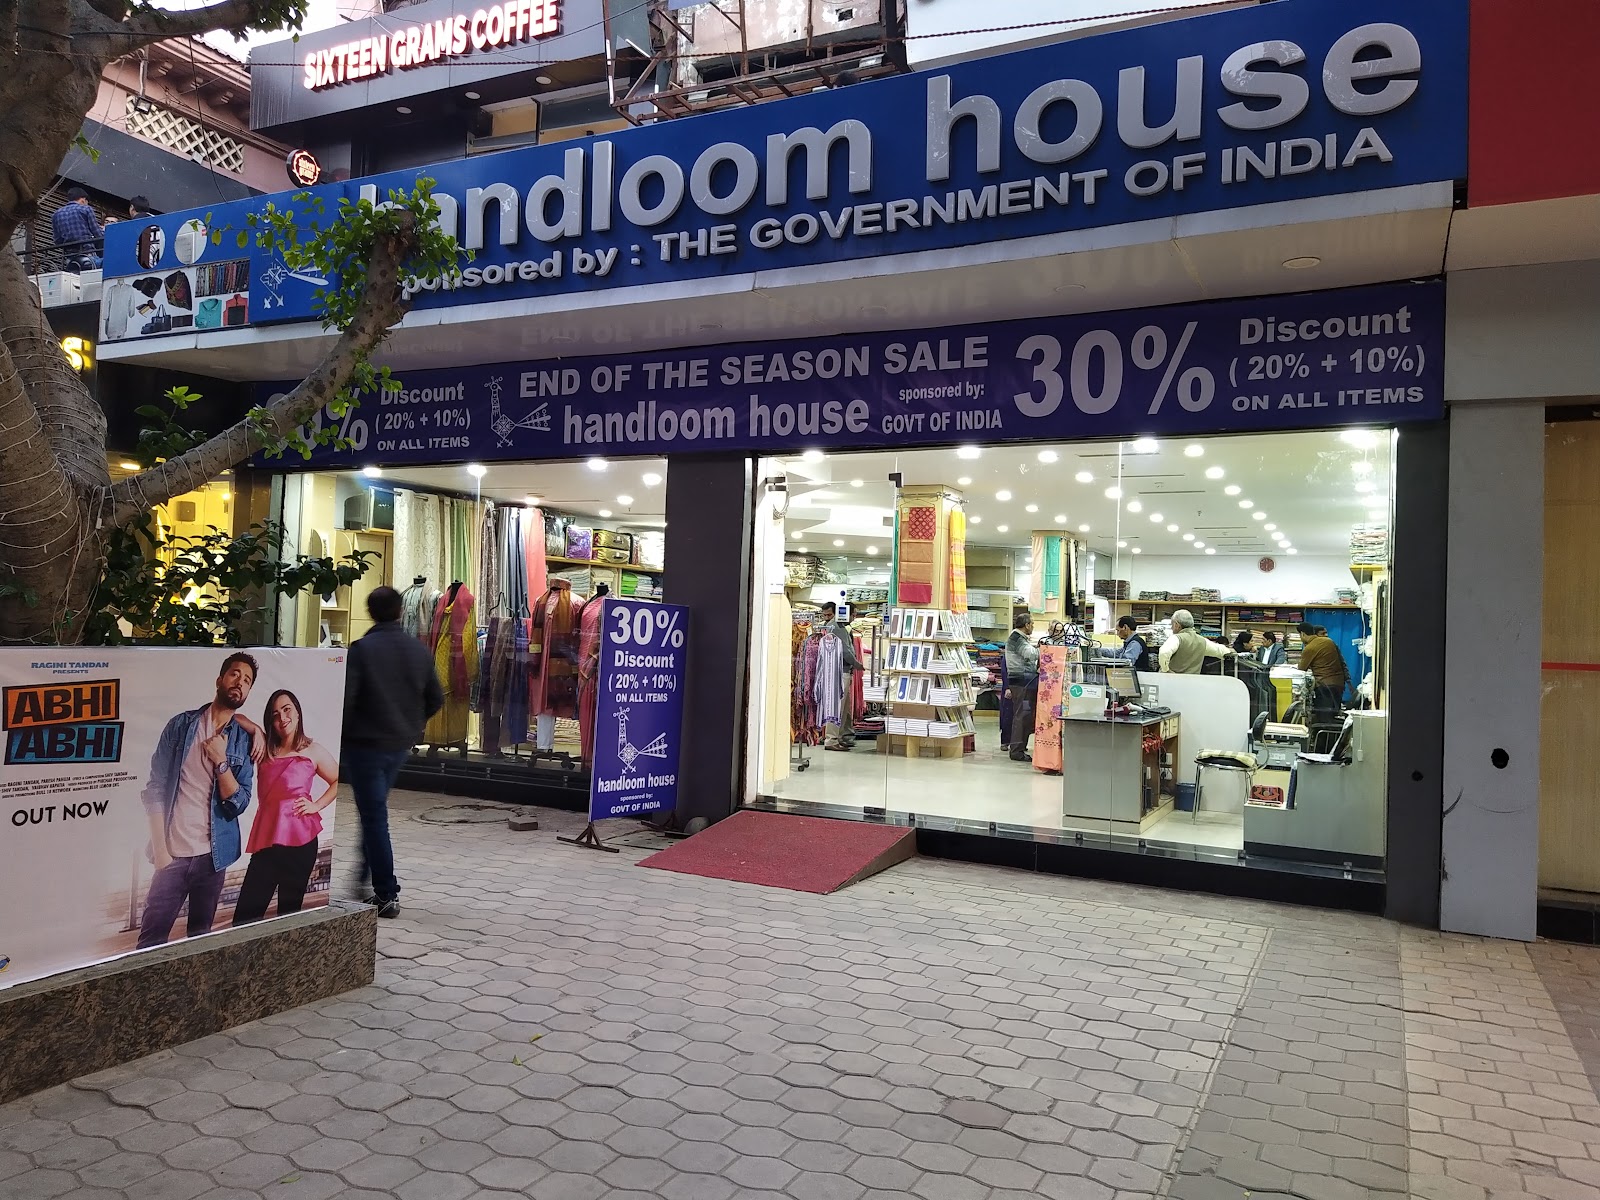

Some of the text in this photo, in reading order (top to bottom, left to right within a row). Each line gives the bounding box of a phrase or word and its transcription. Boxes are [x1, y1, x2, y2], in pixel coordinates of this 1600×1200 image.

[303, 0, 559, 90] SIXTEEN GRAMS COFFEE
[926, 23, 1422, 182] house
[397, 249, 563, 301] ponsored
[572, 247, 619, 277] by
[651, 224, 737, 263] THE
[748, 168, 1108, 250] GOVERNMENT
[1124, 151, 1207, 197] OF
[1220, 126, 1394, 184] INDIA
[1239, 304, 1412, 345] Discount
[519, 335, 991, 399] END OF THE SEASON SALE
[1013, 320, 1216, 418] 30%
[1247, 353, 1310, 381] 20%
[1350, 344, 1426, 377] 10%)
[380, 381, 465, 406] Discount
[898, 381, 985, 402] sponsored by:
[1232, 386, 1424, 412] ON ALL ITEMS
[384, 411, 416, 430] 20%
[433, 408, 471, 431] 10%)
[563, 394, 870, 445] handloom house
[881, 408, 1003, 435] GOVT OF INDIA
[377, 436, 470, 452] ON ALL ITEMS
[609, 605, 685, 649] 30%
[614, 650, 675, 669] Discount
[615, 673, 639, 690] 20%
[651, 674, 677, 691] 10%)
[12, 685, 112, 724] ABHI
[615, 693, 669, 703] ON ALL ITEMS
[14, 726, 116, 760] ABHI
[597, 773, 676, 793] handloom house
[610, 801, 661, 814] GOVT OF INDIA
[620, 794, 645, 802] sponsored
[11, 800, 109, 827] OUT NOW
